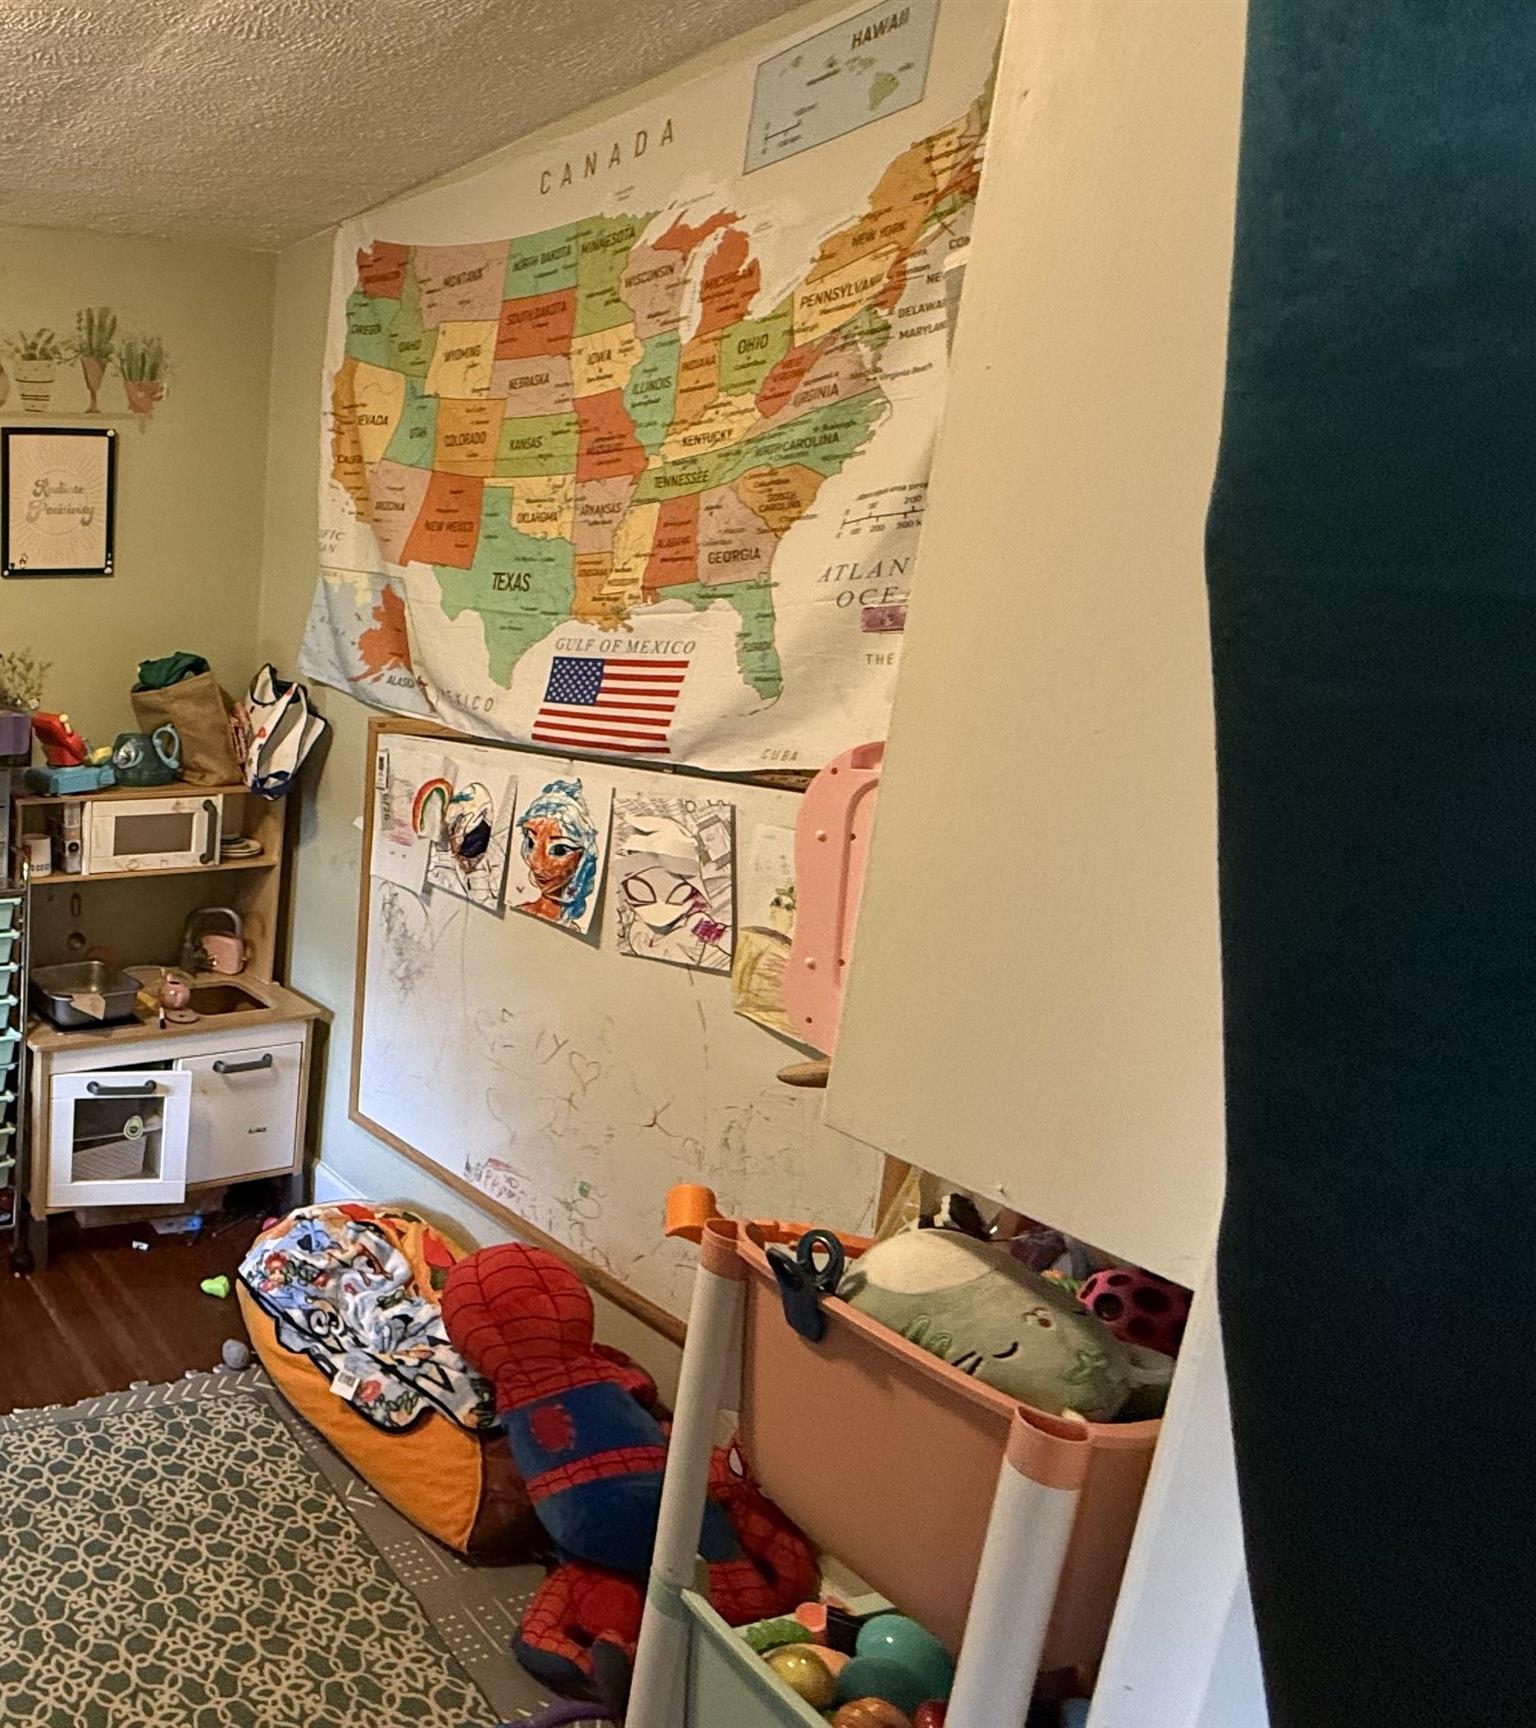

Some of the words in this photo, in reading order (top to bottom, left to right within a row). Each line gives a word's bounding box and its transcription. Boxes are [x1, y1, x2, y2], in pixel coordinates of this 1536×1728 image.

[851, 7, 910, 50] HAWAII
[540, 118, 674, 195] CANADA
[737, 333, 769, 355] OHIO
[587, 349, 612, 366] IOWA
[508, 373, 549, 390] NEBRASKA
[357, 415, 389, 426] EVADA
[509, 436, 543, 450] KANSAS
[682, 428, 734, 446] KENTUCKY
[782, 433, 840, 452] CAROLINA
[516, 512, 558, 524] OKLAHOMA
[707, 547, 762, 565] GEORGIA
[816, 557, 911, 583] ATLAN
[491, 571, 532, 592] TEXAS
[554, 637, 595, 652] GULF
[599, 639, 623, 653] OF
[626, 639, 696, 655] MEXICO
[865, 652, 896, 666] THE
